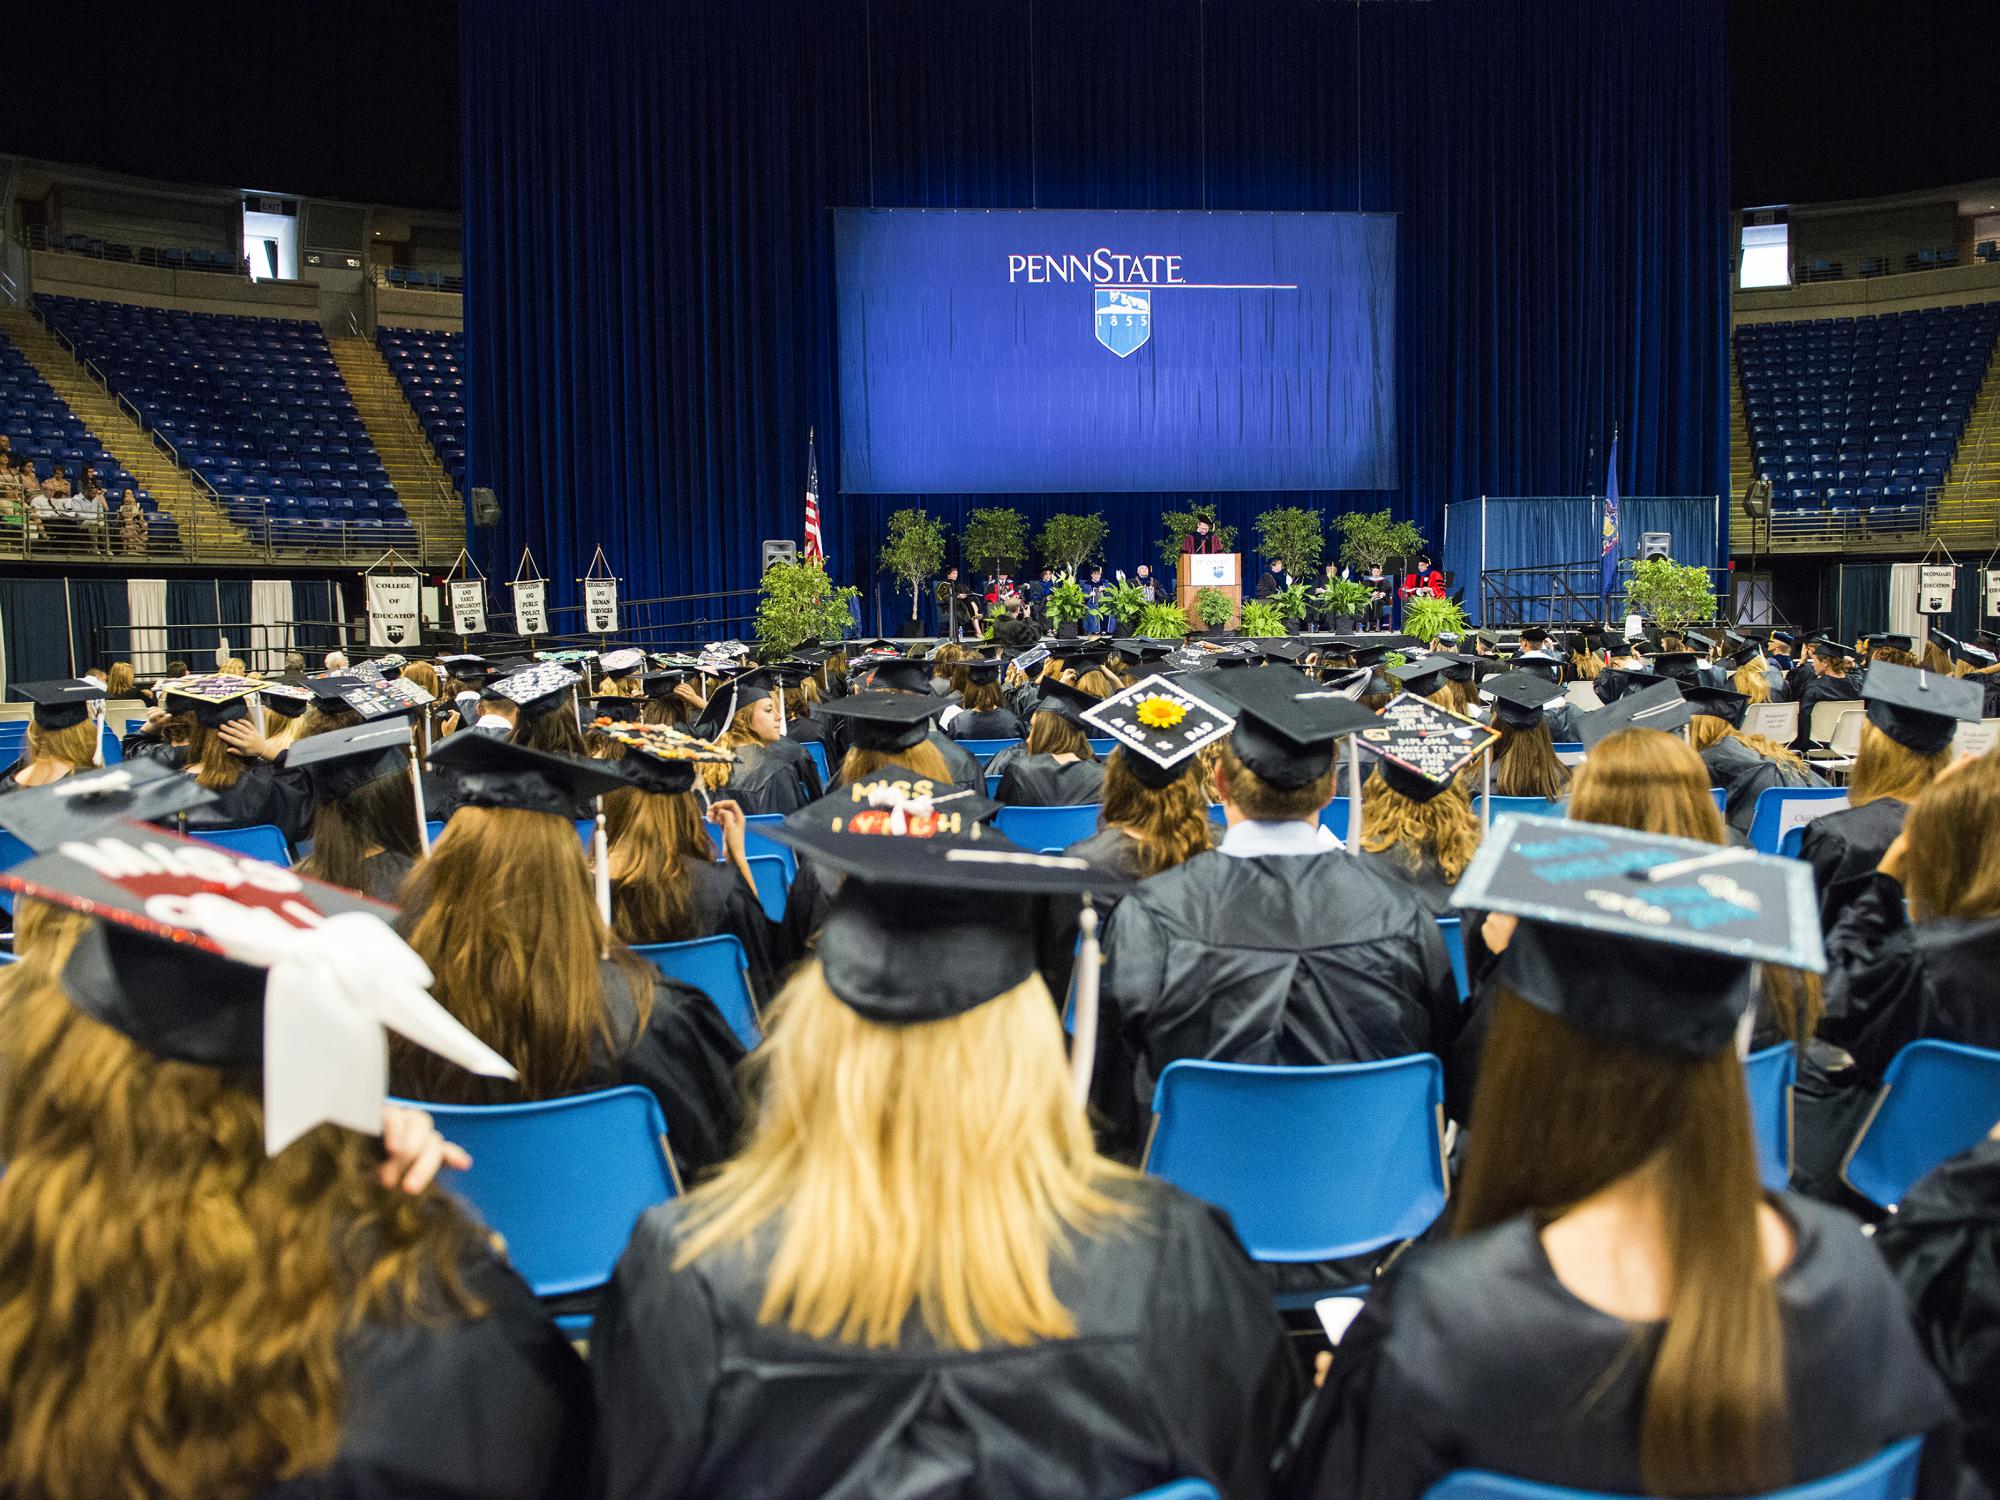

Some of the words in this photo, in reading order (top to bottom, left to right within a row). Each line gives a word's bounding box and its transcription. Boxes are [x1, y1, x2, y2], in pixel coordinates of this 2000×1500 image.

[346, 259, 360, 267] 129
[1097, 315, 1148, 327] 1855
[1397, 737, 1450, 745] DIPLOMA
[1382, 745, 1429, 753] THANKS
[1431, 745, 1448, 753] TO
[852, 779, 934, 803] MISS
